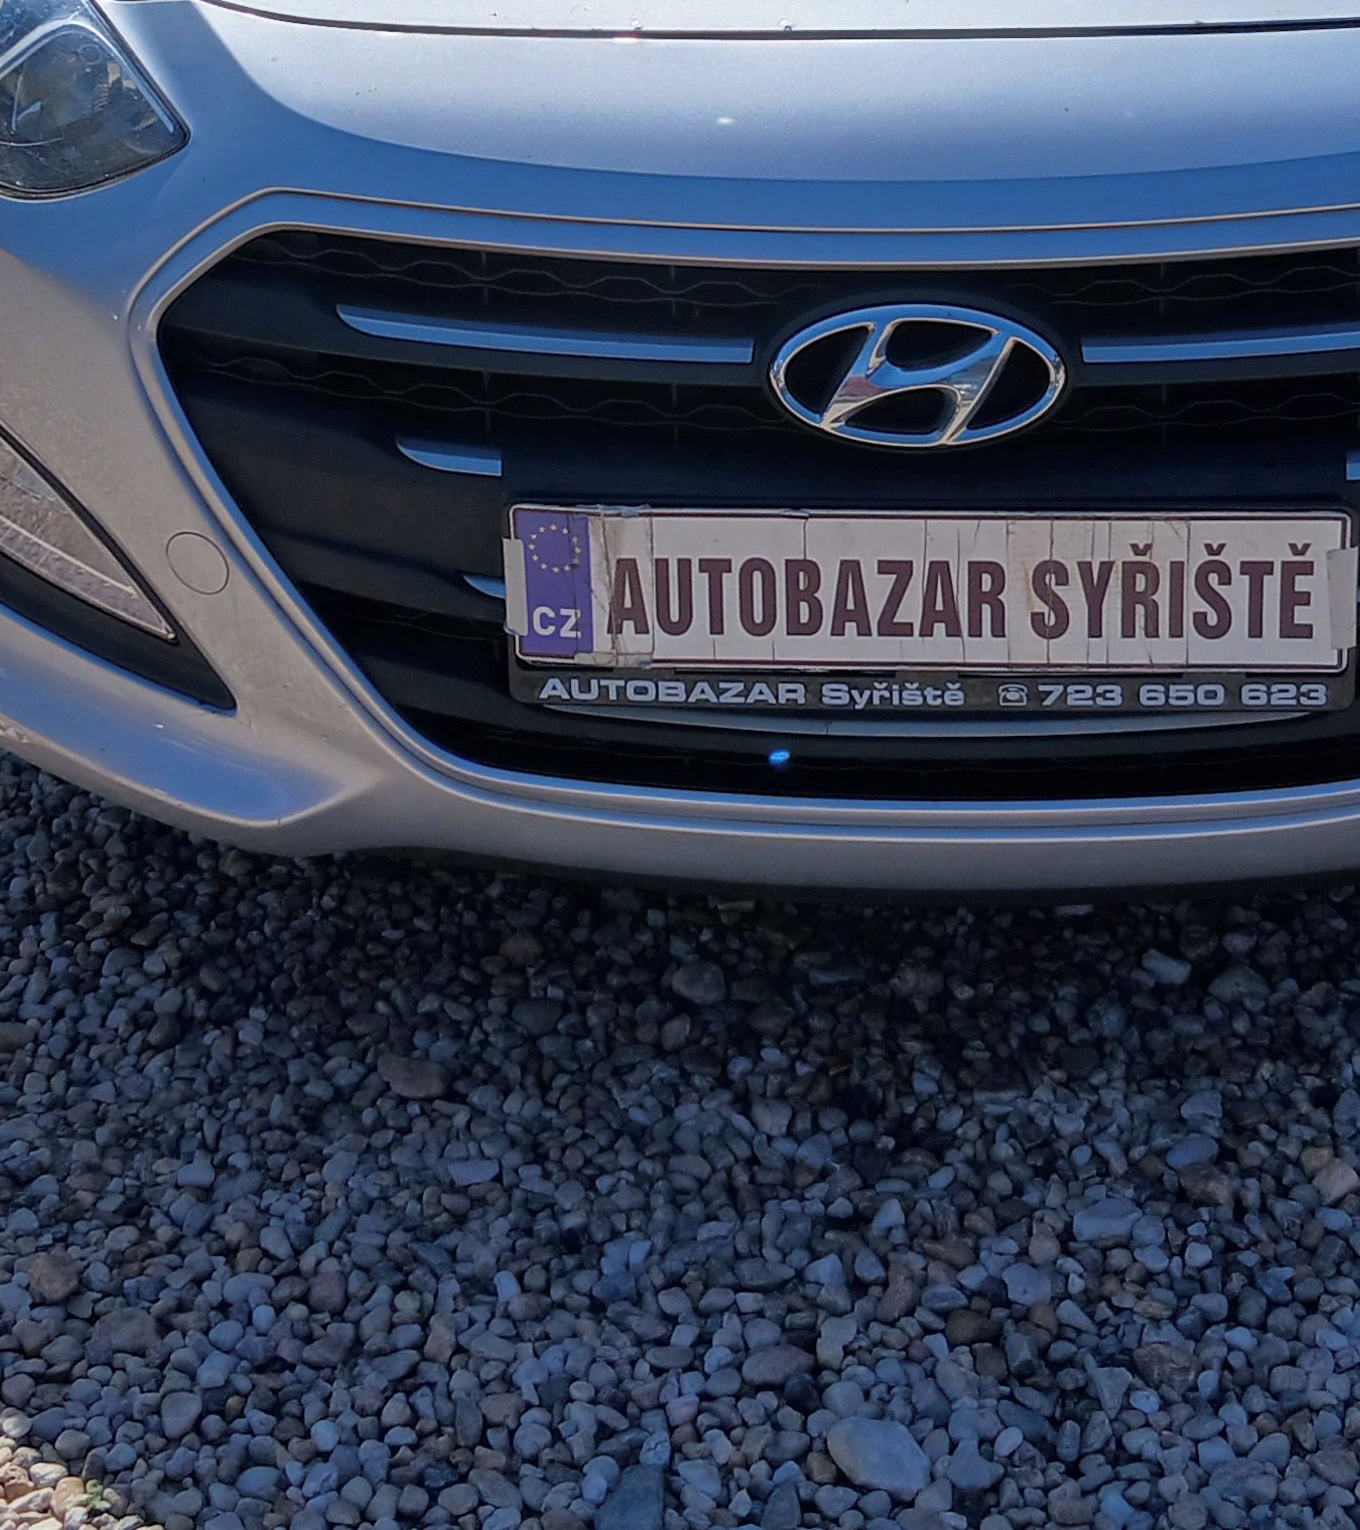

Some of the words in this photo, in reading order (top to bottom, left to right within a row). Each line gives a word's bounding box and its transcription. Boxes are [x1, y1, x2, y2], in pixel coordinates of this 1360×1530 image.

[607, 557, 1007, 639] AUTOBAZAR
[1030, 542, 1316, 641] SYŘIŠTĚ
[533, 606, 583, 639] CZ
[539, 677, 806, 705] AUTOBAZAR
[821, 681, 966, 710] Syřiště
[1038, 683, 1123, 707] 723
[1140, 683, 1226, 707] 650
[1241, 683, 1329, 707] 623
